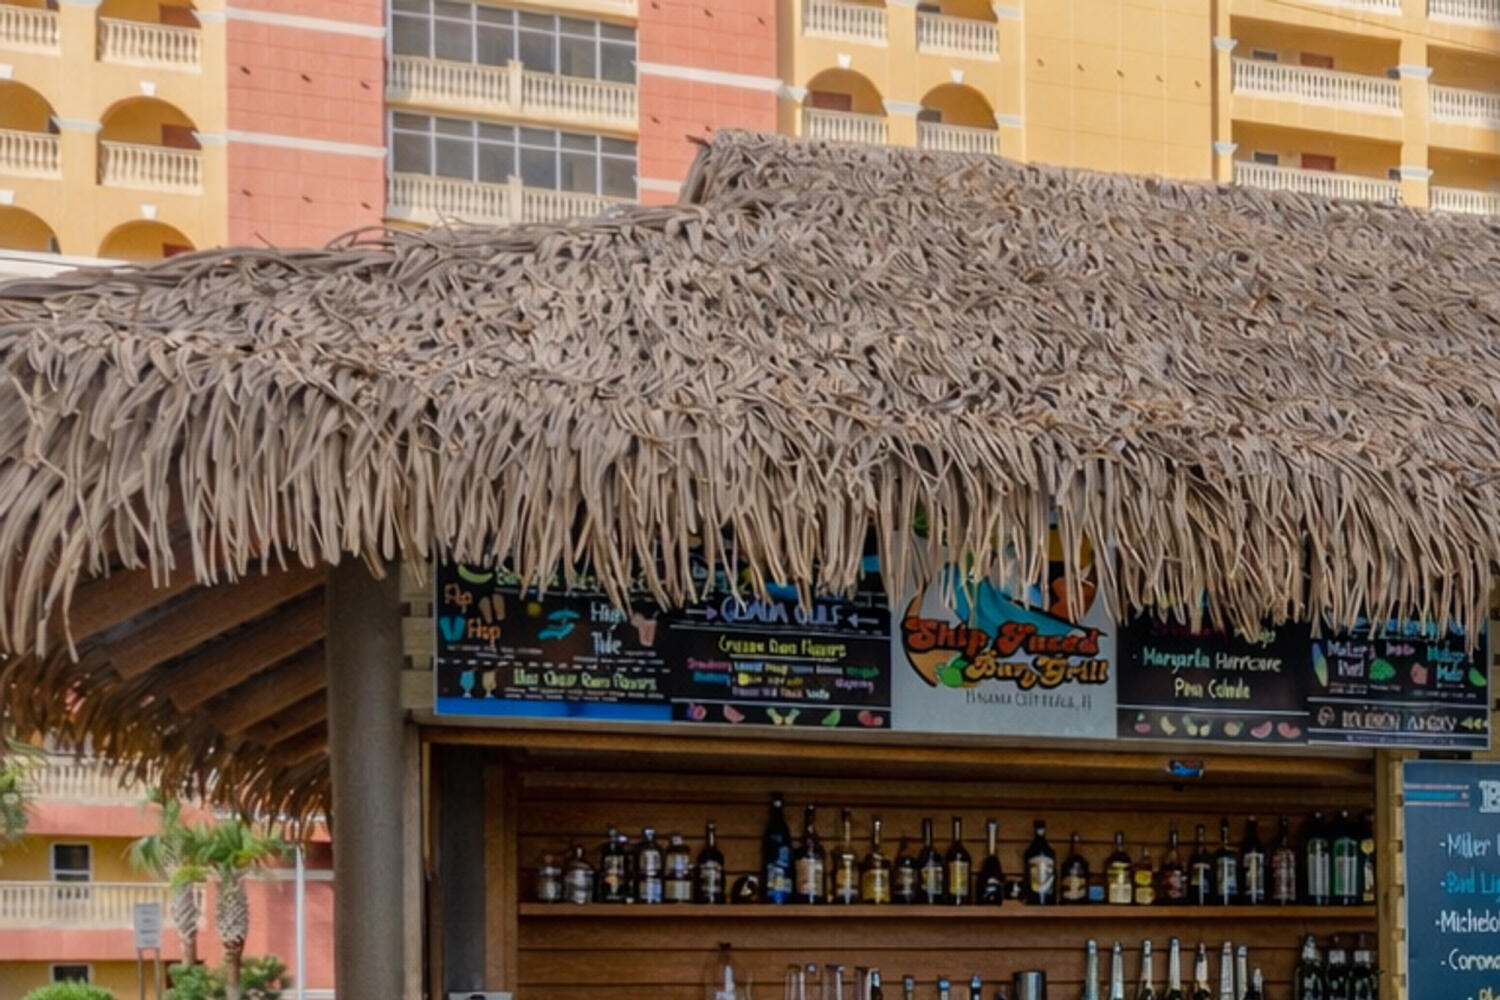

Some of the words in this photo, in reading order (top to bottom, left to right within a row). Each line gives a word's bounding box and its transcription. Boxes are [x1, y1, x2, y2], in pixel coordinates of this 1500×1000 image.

[904, 616, 989, 657] Ship
[1447, 832, 1491, 858] Miller
[1447, 866, 1476, 894] Bud
